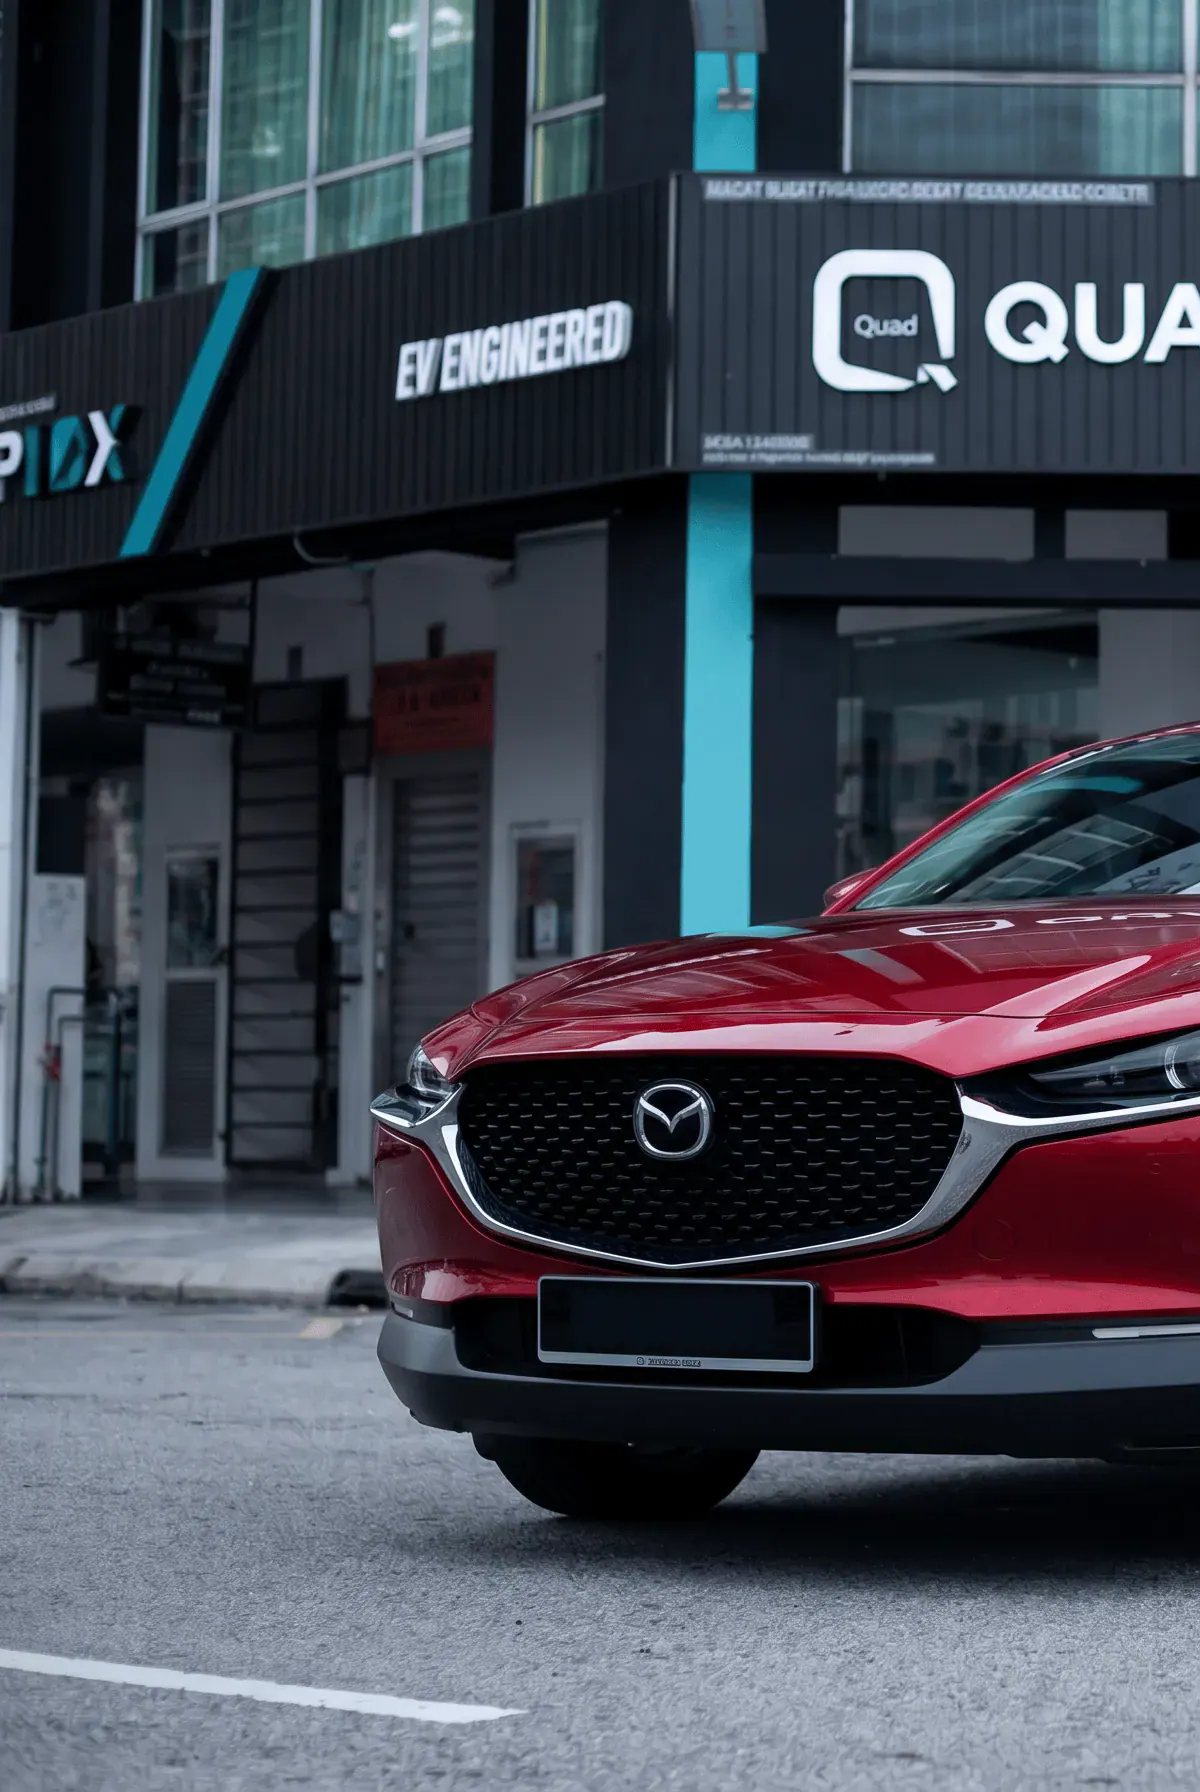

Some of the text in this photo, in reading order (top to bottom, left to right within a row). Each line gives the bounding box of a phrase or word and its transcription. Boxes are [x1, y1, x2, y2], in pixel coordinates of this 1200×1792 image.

[396, 300, 633, 401] EV ENGINEERED
[853, 313, 919, 340] Quad
